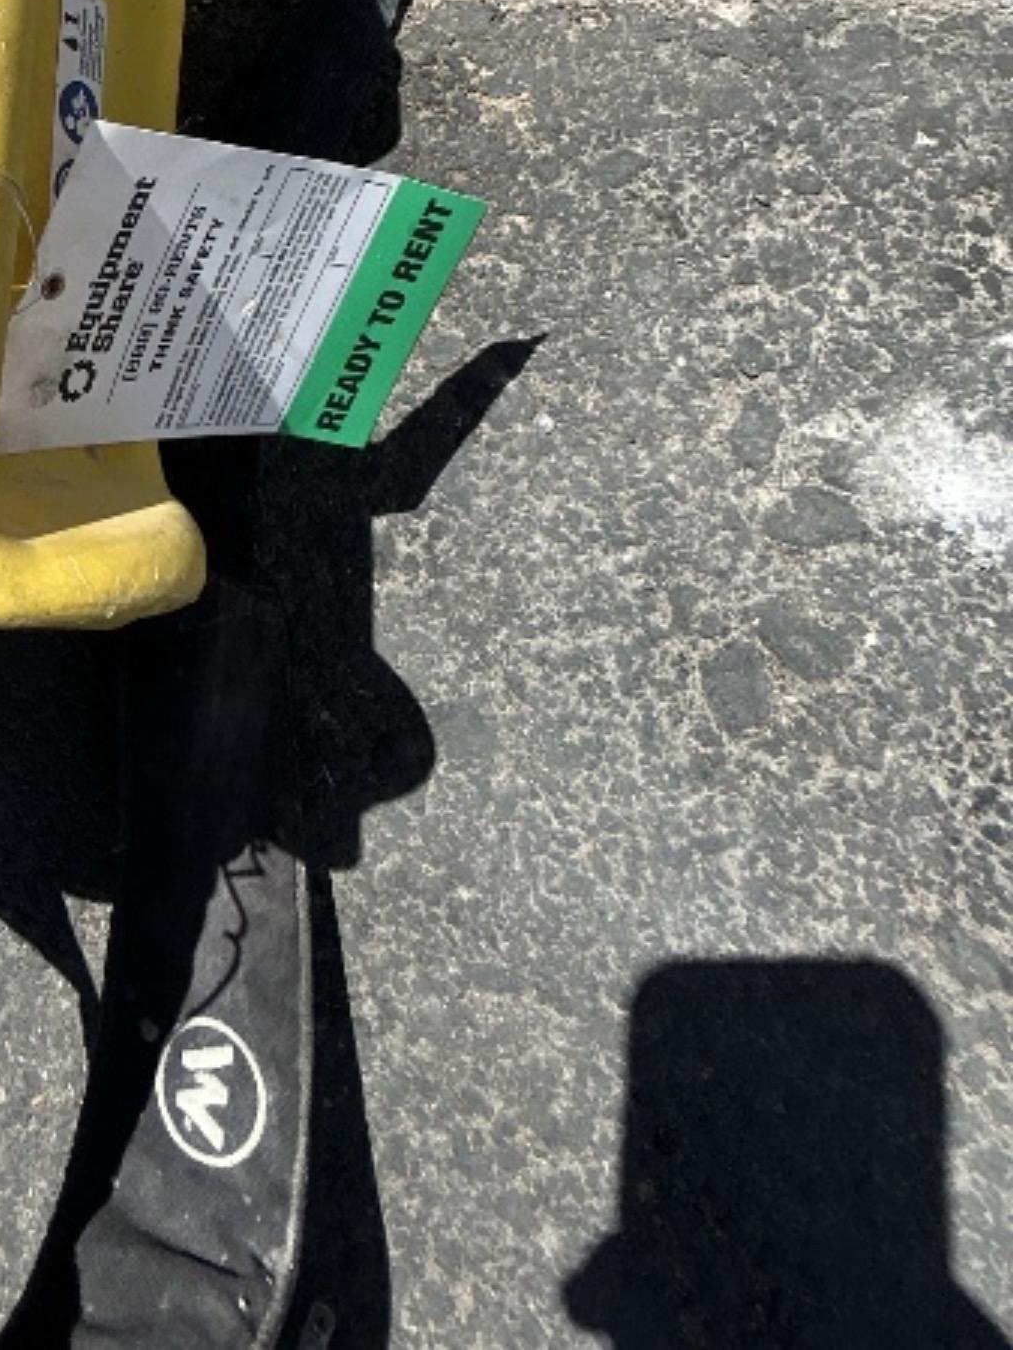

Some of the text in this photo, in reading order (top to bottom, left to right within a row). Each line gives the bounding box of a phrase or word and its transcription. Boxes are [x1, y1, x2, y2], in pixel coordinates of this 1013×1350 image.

[65, 175, 158, 352] Equipment
[92, 260, 144, 352] Share
[148, 304, 186, 372] THINK
[178, 217, 224, 300] SAFETY
[316, 197, 453, 433] READY TO RENT
